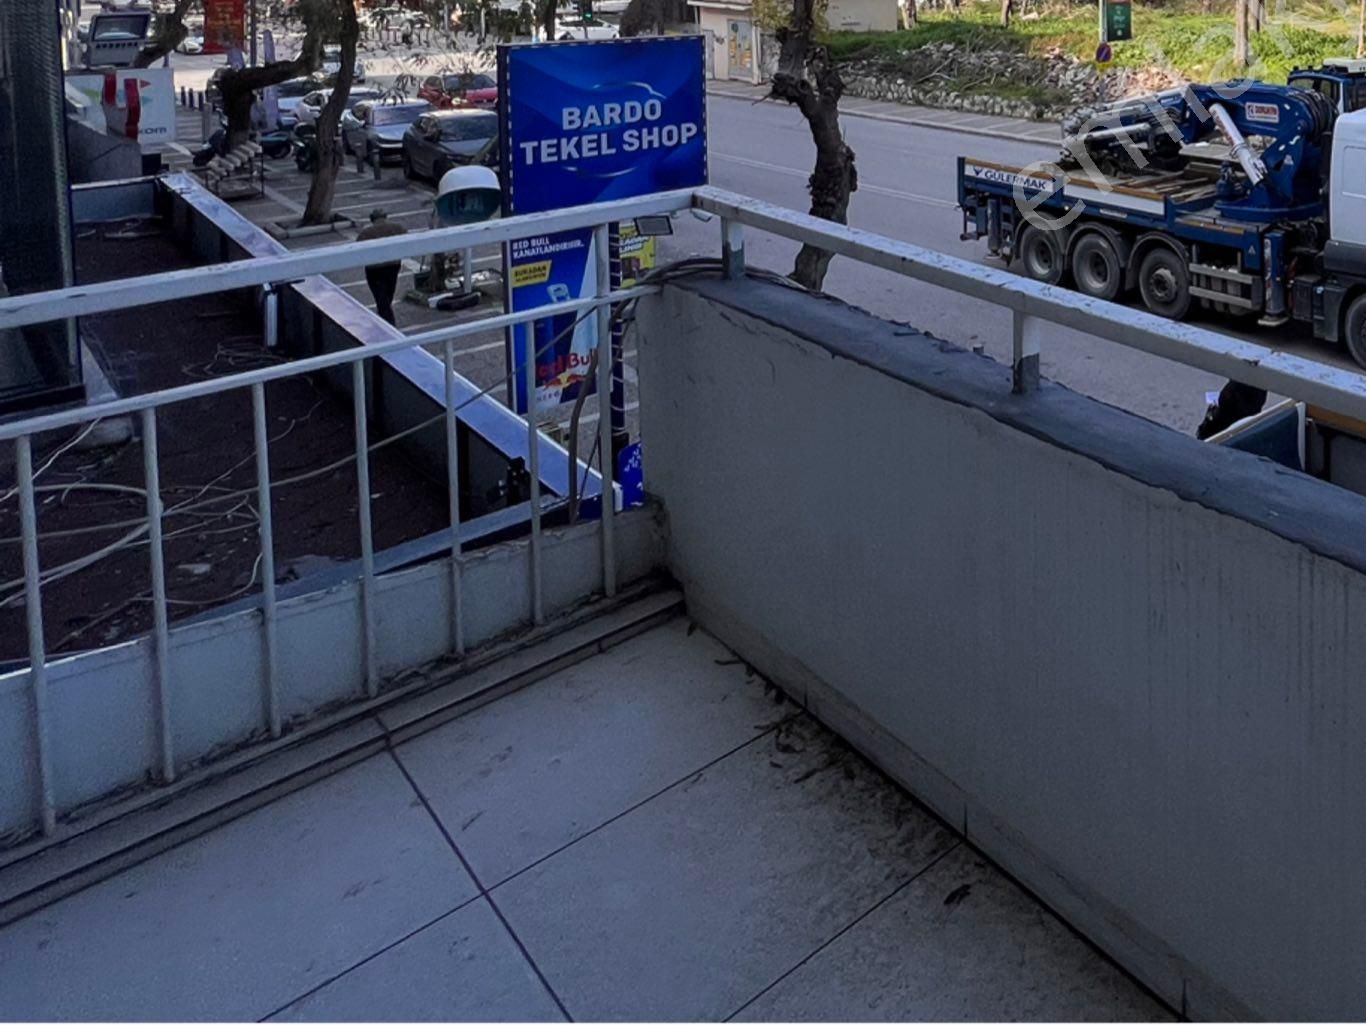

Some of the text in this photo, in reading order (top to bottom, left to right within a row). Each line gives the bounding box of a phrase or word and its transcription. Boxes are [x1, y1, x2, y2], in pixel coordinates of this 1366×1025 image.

[562, 99, 662, 131] BARDO
[520, 122, 698, 165] TEKEL SHOP
[512, 236, 550, 251] RED BULL
